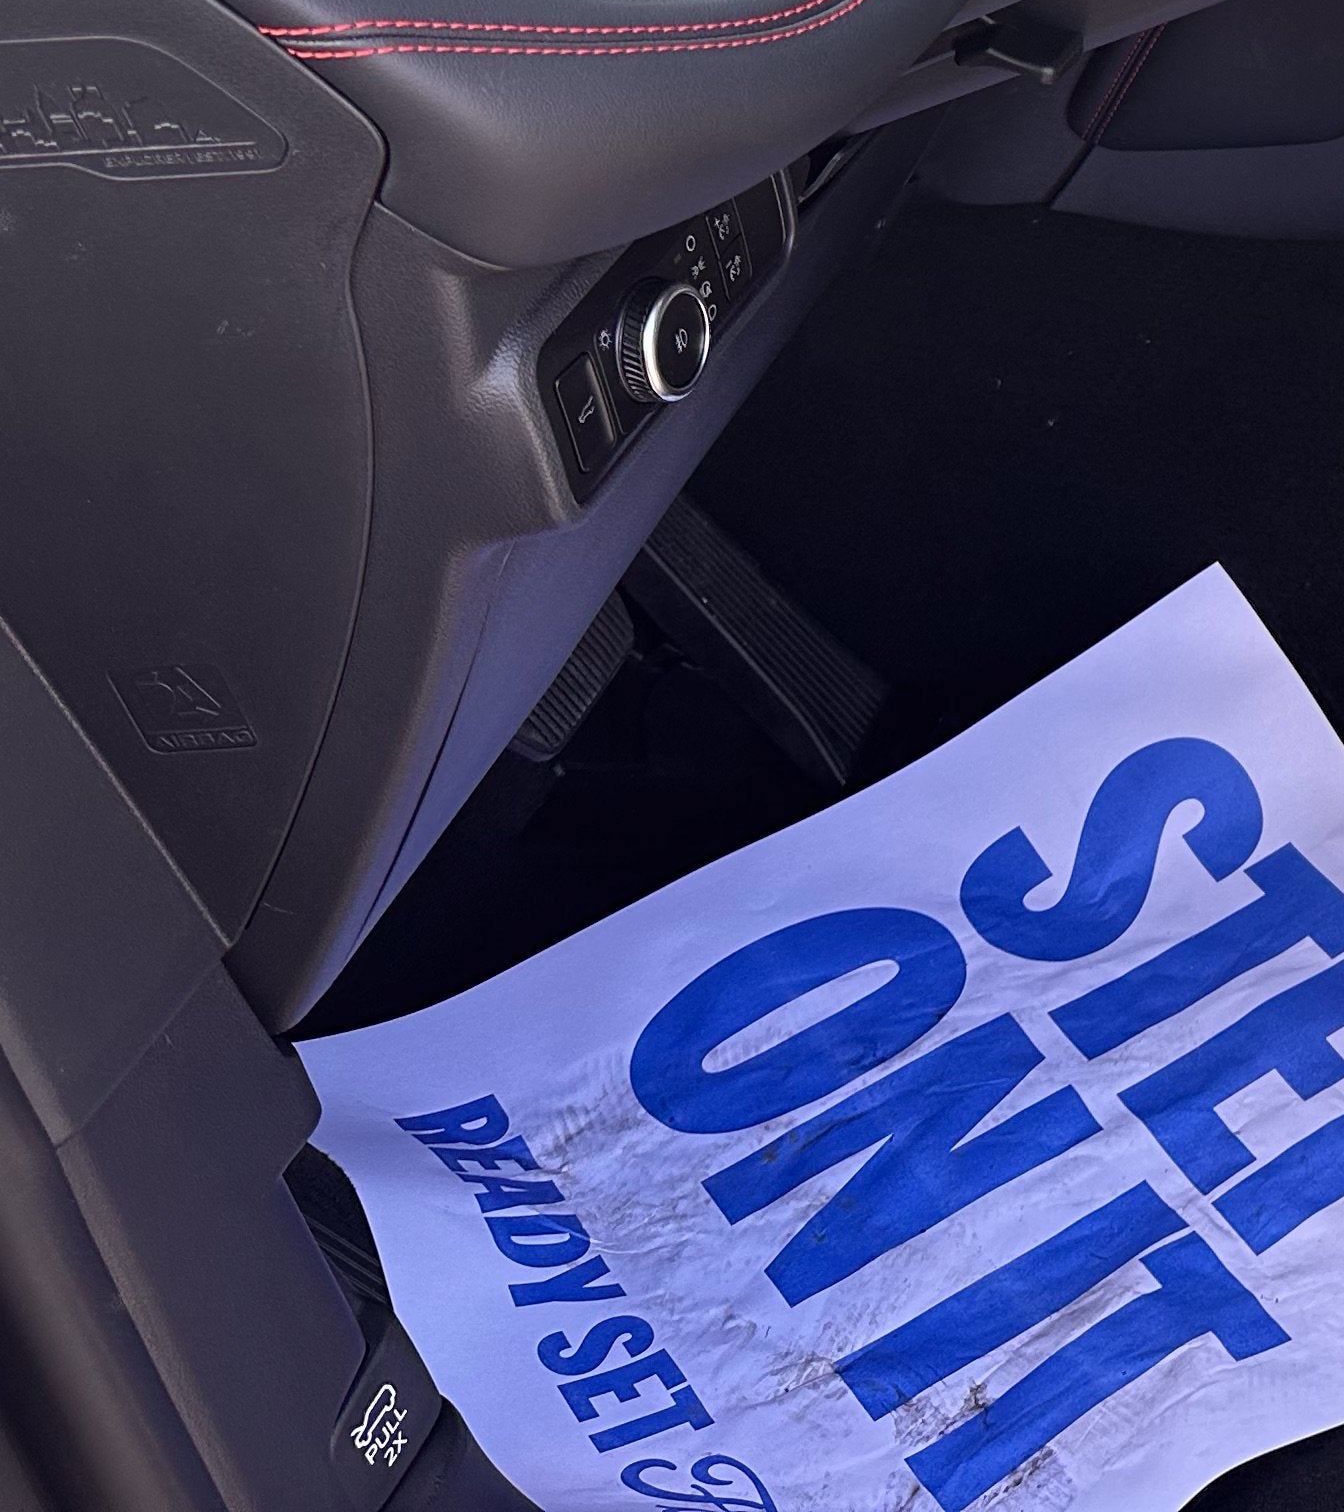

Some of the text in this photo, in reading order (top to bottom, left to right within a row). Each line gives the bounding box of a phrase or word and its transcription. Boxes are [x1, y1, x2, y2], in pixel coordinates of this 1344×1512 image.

[393, 1093, 627, 1308] READY
[537, 1315, 715, 1454] SET
[629, 906, 1292, 1512] ON IT
[365, 1409, 408, 1465] PULL
[384, 1431, 408, 1467] 2X
